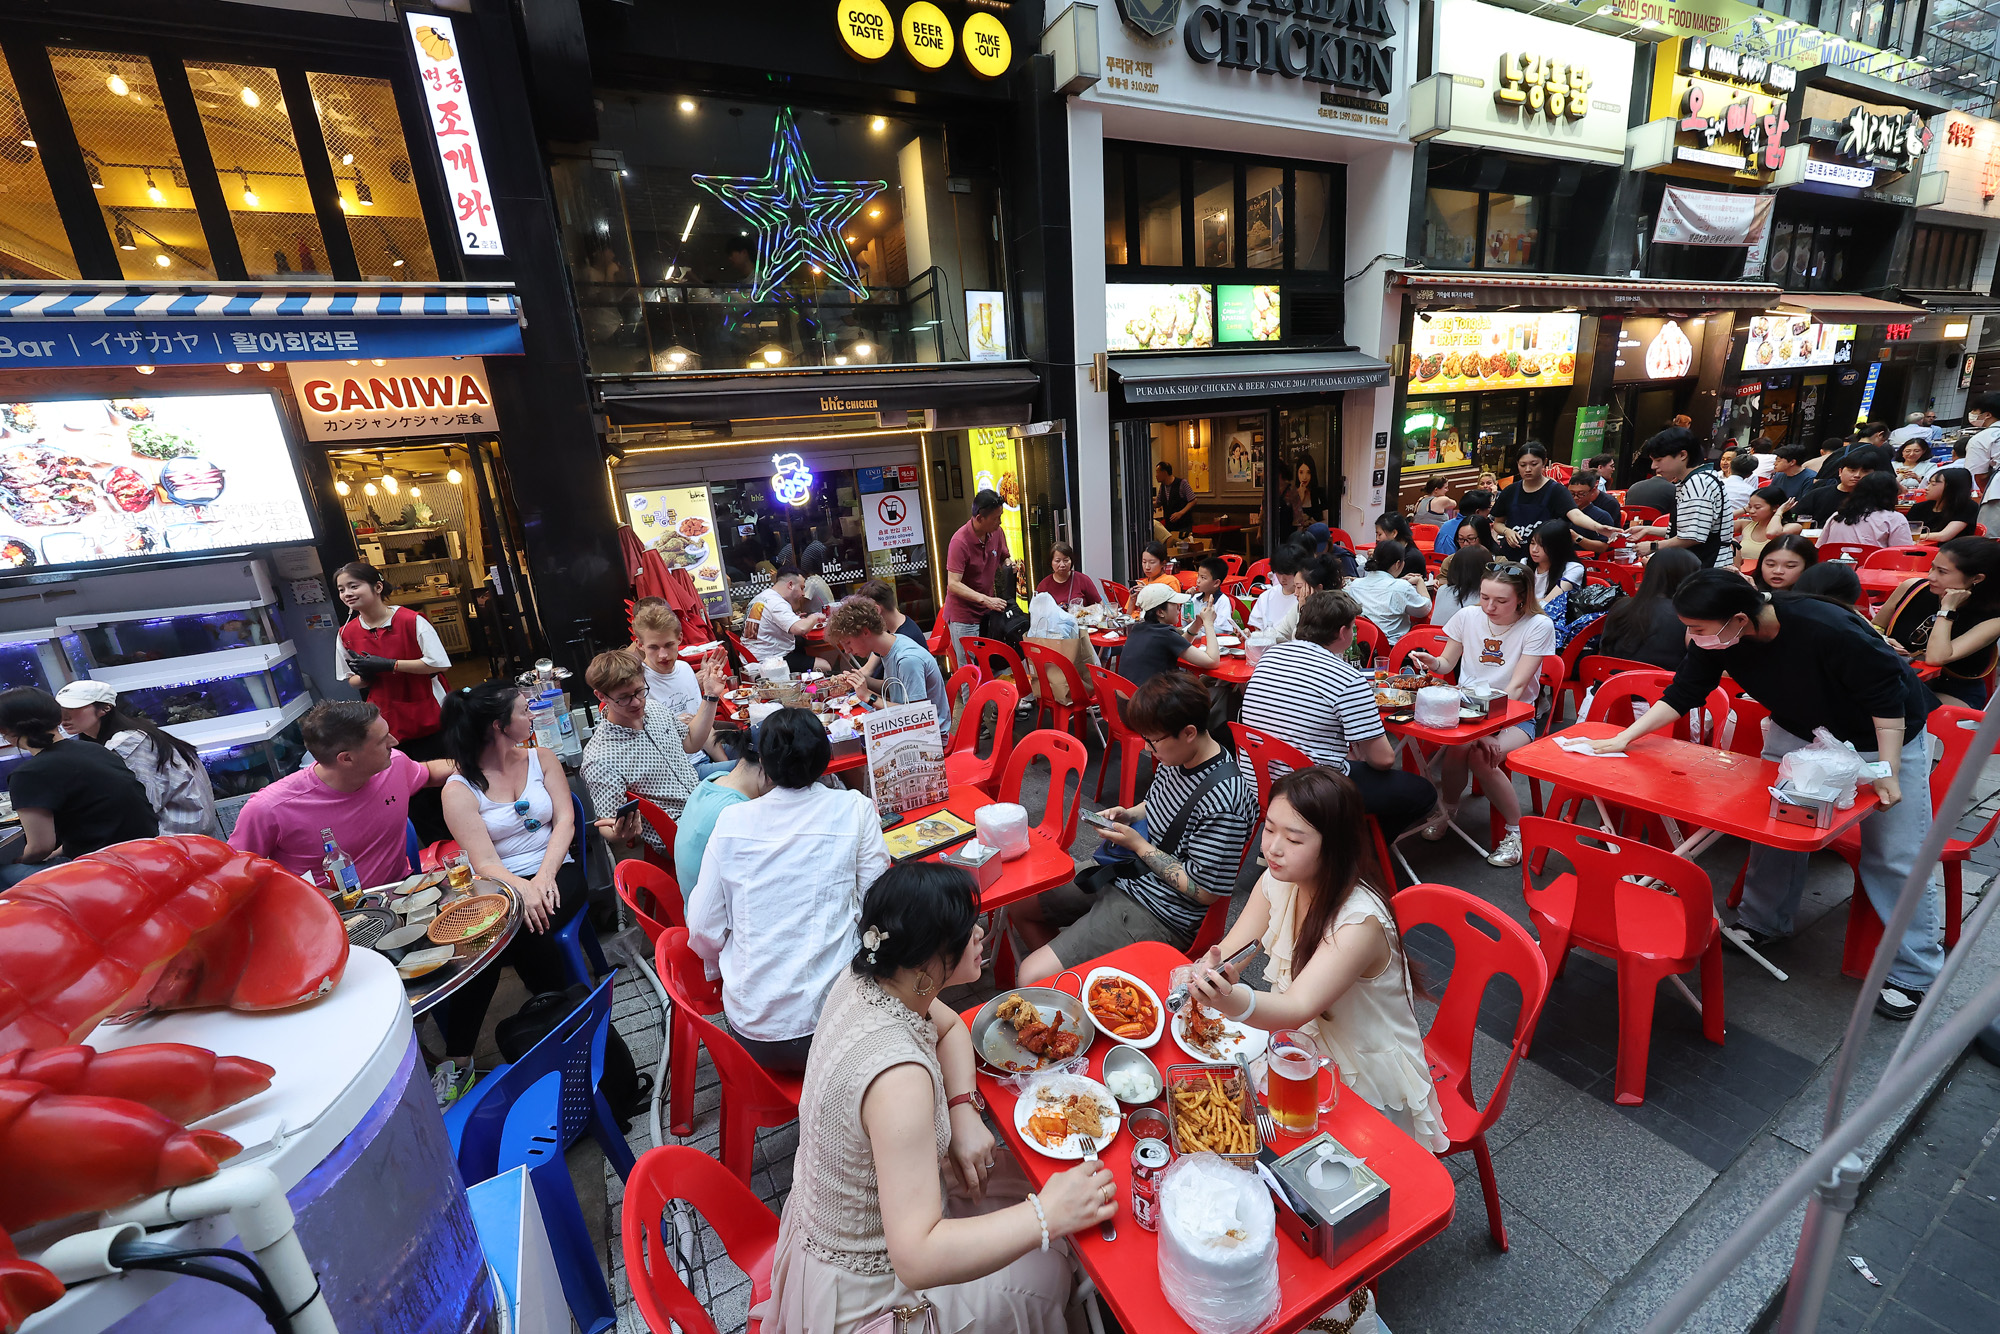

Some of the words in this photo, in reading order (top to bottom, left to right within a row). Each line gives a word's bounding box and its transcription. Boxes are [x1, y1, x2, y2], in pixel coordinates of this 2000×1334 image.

[848, 11, 883, 27] GOOD
[1668, 8, 1691, 28] FOOD
[1693, 13, 1730, 35] MAKER!!!
[849, 24, 884, 41] TASTE
[913, 21, 942, 37] BEER
[914, 34, 944, 50] ZONE
[975, 32, 1000, 46] TAKE
[1775, 28, 1798, 60] NY
[1184, 4, 1396, 97] CHICKEN
[1135, 60, 1153, 78] 치킨
[422, 67, 463, 93] 명동
[1499, 51, 1593, 117] 노랑통닭
[436, 100, 491, 227] 조개와
[1455, 316, 1491, 333] Tongdak
[90, 331, 199, 355] イザカヤ
[230, 330, 360, 354] 활어회전문
[1462, 333, 1482, 346] BEER
[1135, 385, 1176, 396] PURADAK
[1177, 384, 1199, 395] SHOP
[1201, 382, 1236, 393] CHICKEN
[1238, 382, 1244, 391] &
[1246, 381, 1265, 391] BEER
[1270, 379, 1291, 389] SINCE
[1292, 378, 1306, 388] 2014
[1311, 377, 1342, 388] PURADAK
[1344, 375, 1364, 386] LOVES
[1366, 374, 1382, 384] YOU!
[1842, 373, 1856, 381] ADT
[304, 375, 488, 412] GANIWA
[820, 396, 844, 411] bhc
[845, 399, 878, 410] CHICKEN
[323, 412, 484, 432] カンジャンケジャン定食
[751, 494, 764, 502] bhc
[641, 497, 677, 528] 뿌링클
[897, 532, 914, 540] allowed
[890, 550, 908, 564] bhc
[822, 559, 842, 574] bhc
[750, 568, 771, 584] bhc
[870, 710, 934, 735] SHINSEGAE
[893, 744, 919, 755] SHINSEGAE
